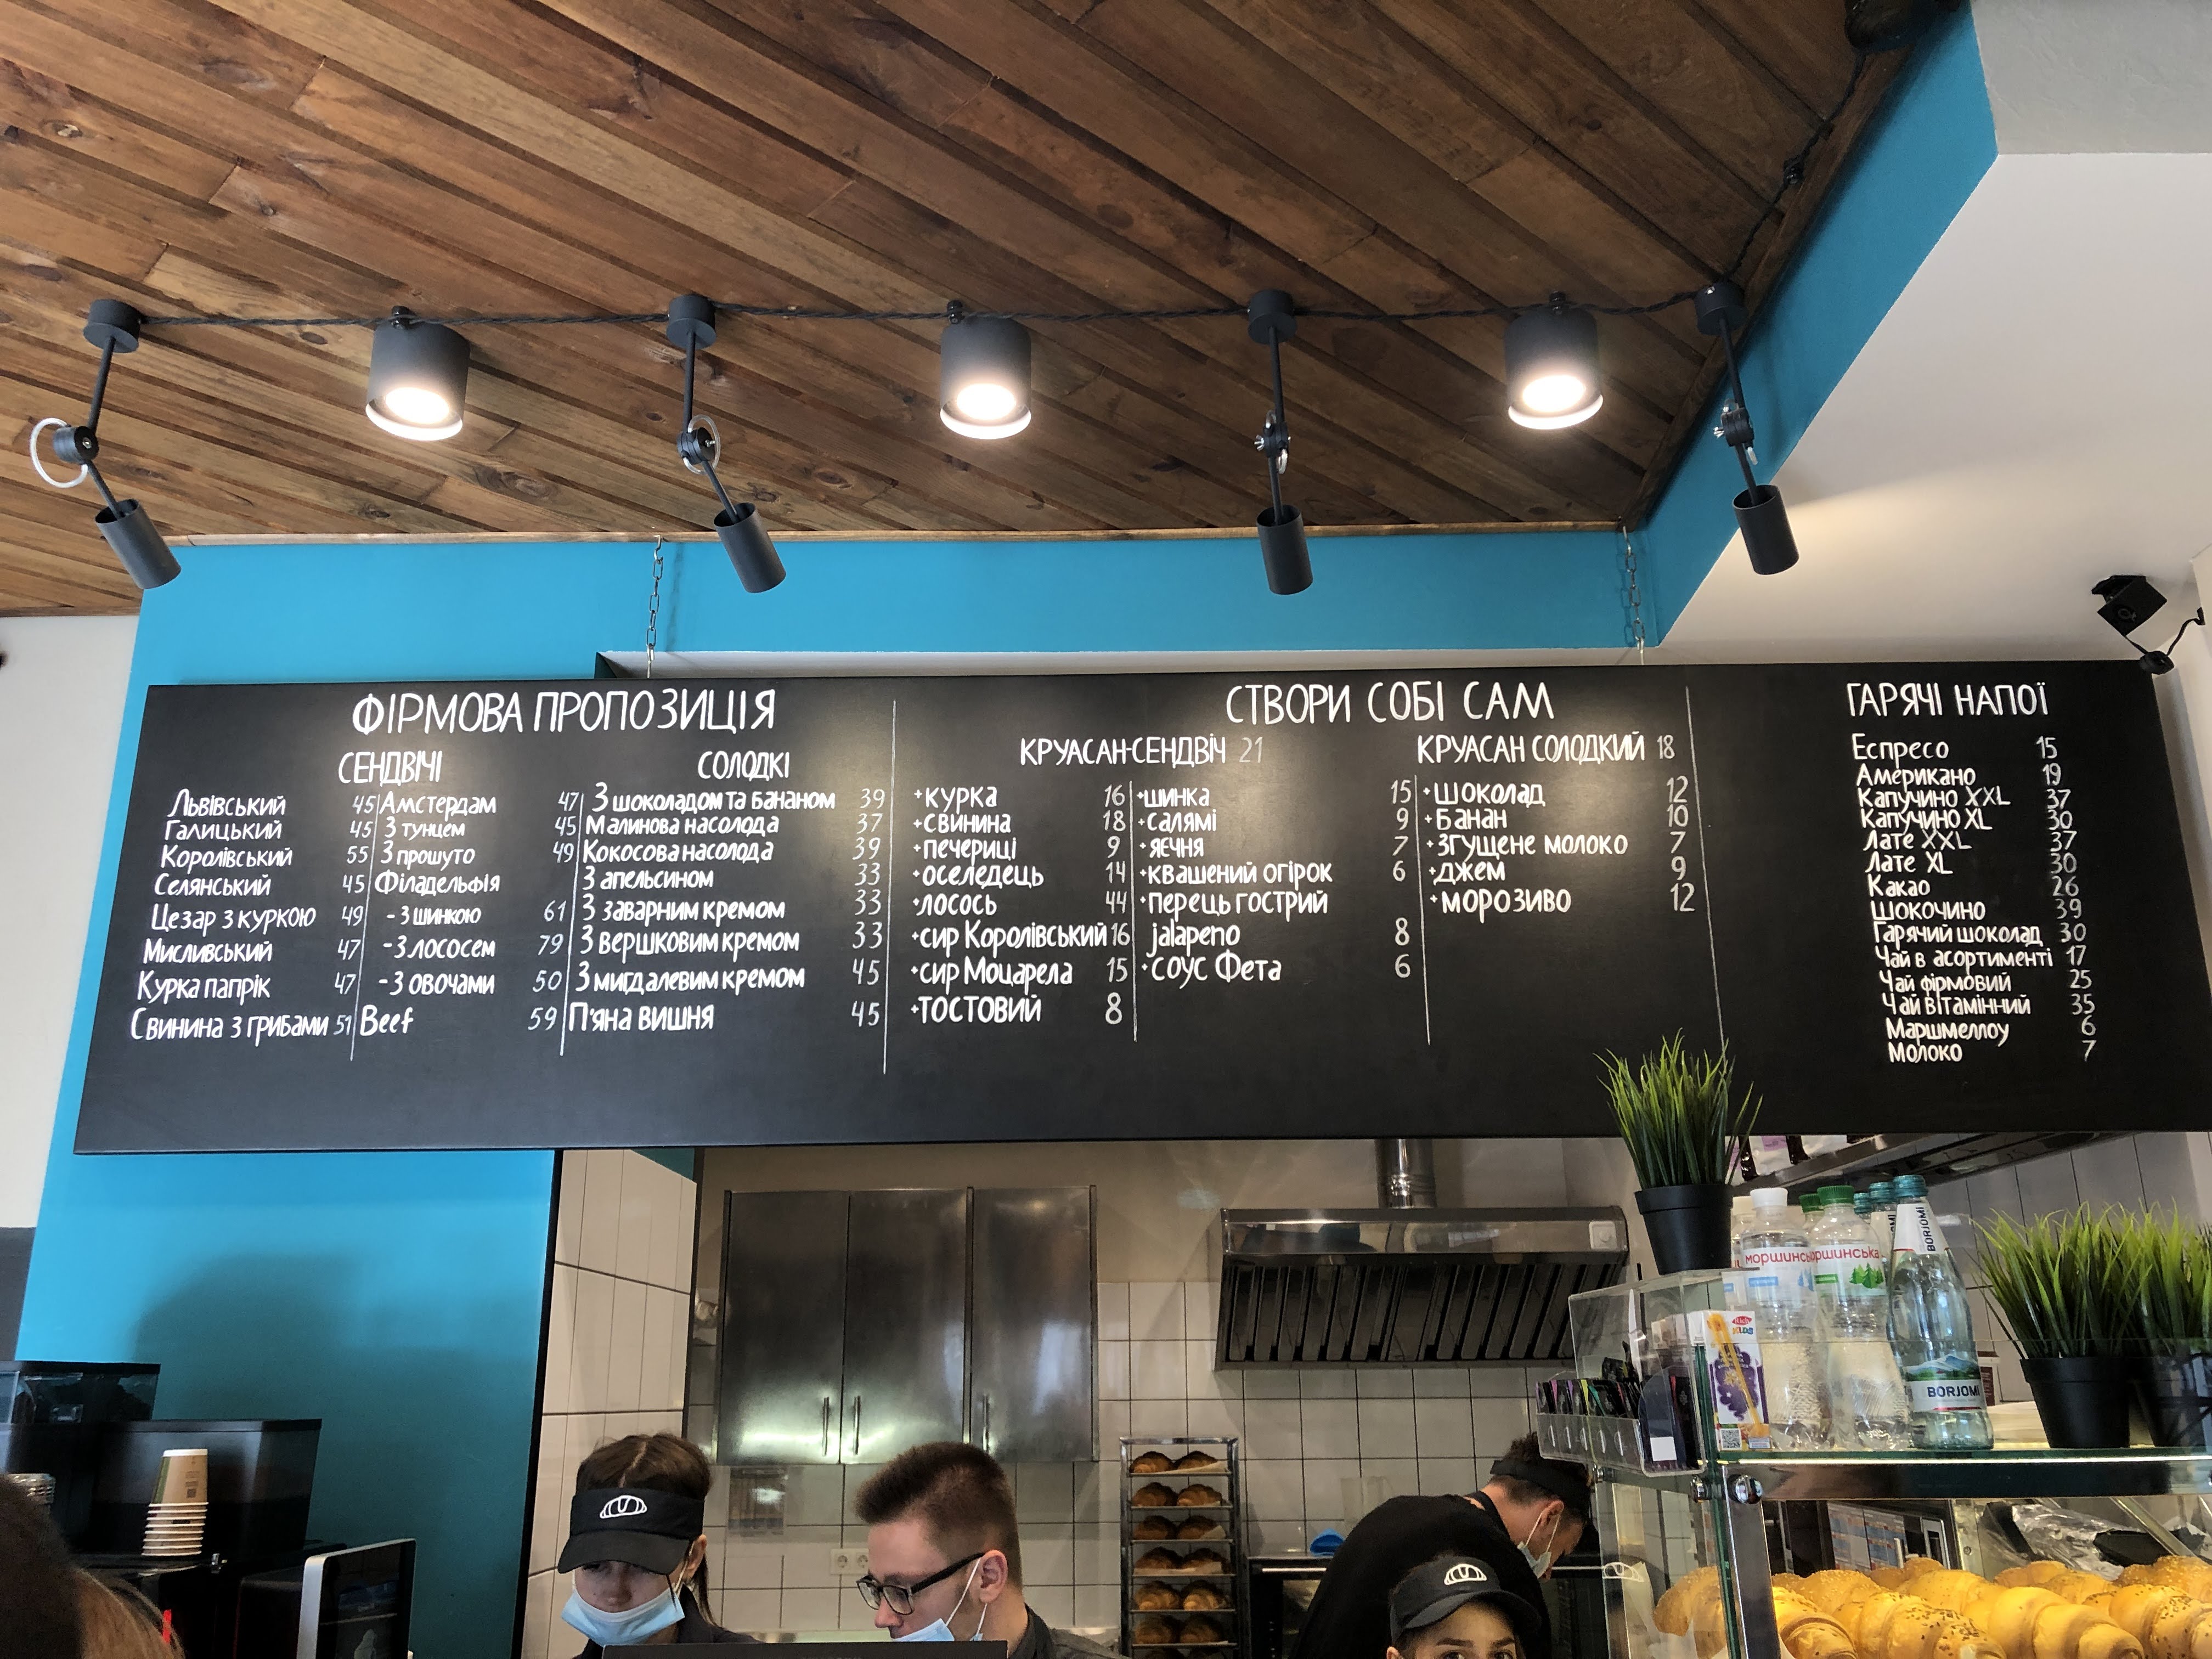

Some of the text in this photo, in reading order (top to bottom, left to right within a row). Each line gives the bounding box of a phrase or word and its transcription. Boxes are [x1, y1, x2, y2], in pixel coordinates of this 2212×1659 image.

[352, 688, 776, 735] ФІРМОВА ПРОПОЗИЦІЯ
[1226, 680, 1555, 725] СТВОРИ СОБІ САМ
[1846, 681, 2049, 717] ГАРЯЧІ НАПОЇ
[1239, 736, 1263, 763] 21
[1417, 731, 1675, 765] КРУАСАН СОЛОДКИЙ 18
[1852, 732, 2058, 770] Еспресо 15
[338, 750, 443, 787] СЕНДВІЧІ
[697, 750, 790, 782] СОЛОДКІ
[1855, 762, 2062, 795] Американо 19
[166, 788, 377, 817] Львівський 45
[612, 788, 885, 815] шоколадом та бананом 39
[1104, 784, 1126, 808] 16
[1391, 779, 1412, 804] 15
[1666, 775, 1689, 803] 12
[1857, 785, 2072, 816] Капучино XXL 37
[379, 791, 580, 823] Амстердам 47
[1103, 810, 1126, 832] 18
[1396, 807, 1409, 831] 9
[1666, 804, 1689, 827] 10
[164, 819, 374, 842] Галицький 45
[401, 815, 577, 841] тунцем 45
[585, 812, 883, 838] Малинова насолода 37
[1860, 807, 2073, 836] Капучино XL 30
[583, 837, 881, 864] Кокосова насолода 39
[1107, 836, 1121, 859] 9
[1392, 836, 1409, 856] 7
[1544, 834, 1628, 855] молоко
[1669, 831, 1686, 854] 7
[1863, 829, 2078, 853] Лате XXL 37
[160, 844, 369, 875] Королівський 55
[396, 840, 574, 871] прошуто 49
[1671, 856, 1686, 881] 9
[1864, 850, 2078, 874] Лате XL 30
[154, 872, 365, 896] Селянський 45
[374, 869, 501, 897] Філадельфія
[600, 862, 881, 890] апельсином 33
[1105, 860, 1126, 884] 14
[1263, 860, 1333, 891] огірок
[1392, 860, 1406, 882] 6
[1867, 873, 2079, 898] Какао 26
[601, 888, 882, 928] заварним кремом 33
[1105, 890, 1127, 915] 44
[1235, 889, 1328, 923] гострий
[1670, 882, 1695, 912] 12
[2055, 898, 2082, 919] 39
[151, 902, 364, 938] Цезар куркою 49
[413, 900, 567, 926] шинкою 61
[599, 921, 883, 964] вершковим кремом 33
[965, 919, 1131, 959] Королівський 16
[1395, 917, 1410, 946] 8
[1872, 920, 2086, 953] Гарячий шоколад 30
[142, 937, 362, 964] Мисливський 47
[407, 933, 564, 960] лососем 79
[1874, 944, 1911, 968] Чай
[1931, 947, 2053, 977] асортименті
[2066, 944, 2087, 966] 17
[594, 957, 881, 996] мигдалевим кремом 45
[964, 955, 1128, 997] Моцарела 15
[1215, 948, 1411, 983] Фета 6
[137, 969, 357, 1006] Курка папрік 47
[408, 969, 562, 995] овочами 50
[1878, 968, 2092, 998] Чай фірмовий 25
[851, 1000, 880, 1028] 45
[1105, 991, 1122, 1025] 8
[1881, 992, 2095, 1015] Чай вітамінний 35
[130, 1007, 352, 1047] Свинина грибами 51
[359, 1004, 557, 1036] Beef 59
[2081, 1014, 2097, 1036] 6
[1887, 1039, 2097, 1063] Молоко 7
[1915, 1206, 1936, 1251] BORJOMI
[1745, 1251, 1810, 1266] моршинсь
[1810, 1246, 1880, 1263] оршинська
[1927, 1385, 1980, 1397] BORJOMI
